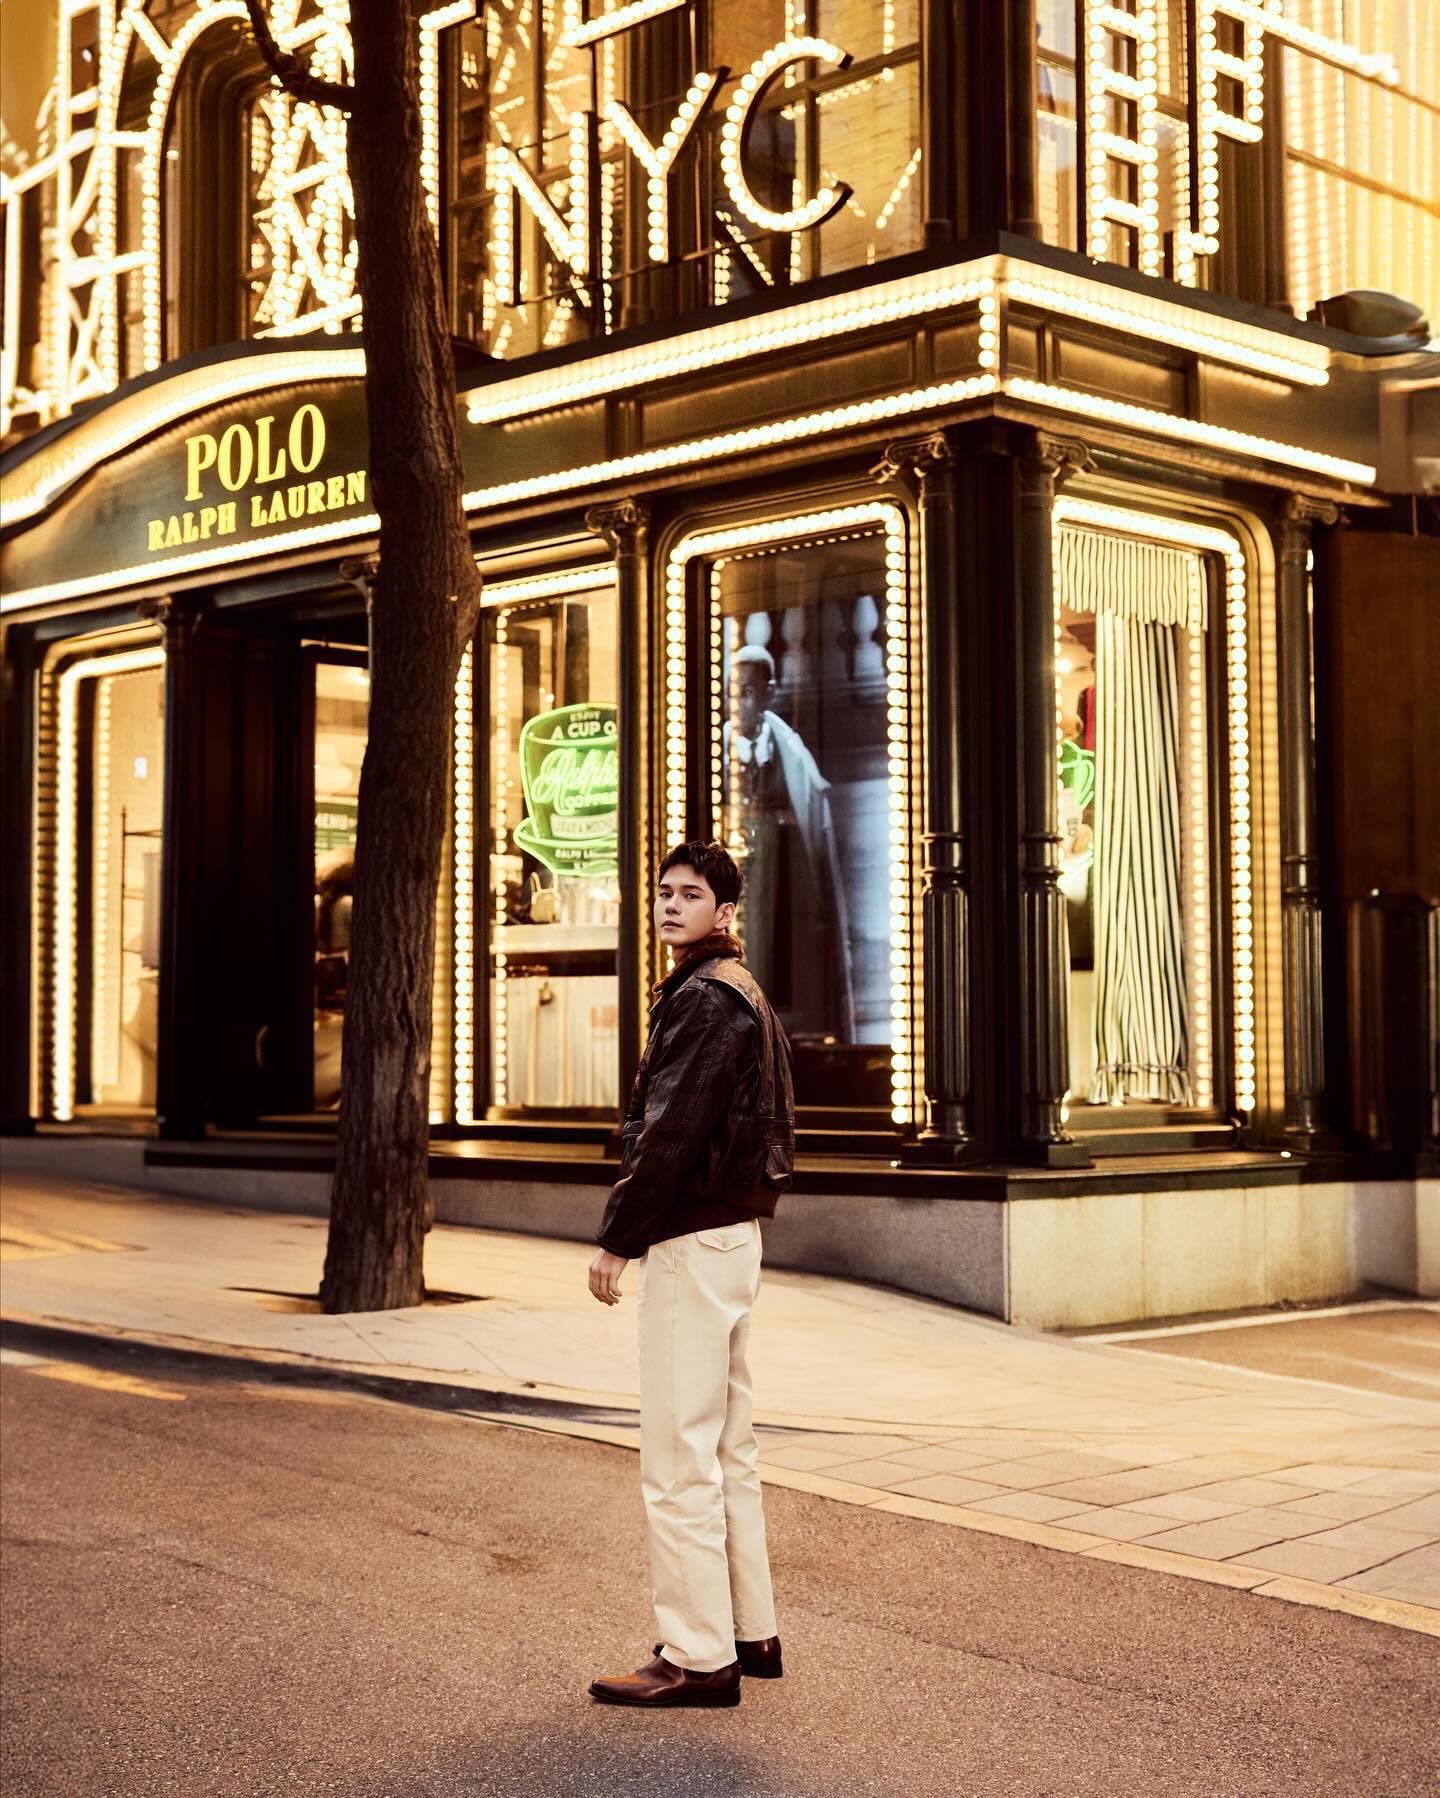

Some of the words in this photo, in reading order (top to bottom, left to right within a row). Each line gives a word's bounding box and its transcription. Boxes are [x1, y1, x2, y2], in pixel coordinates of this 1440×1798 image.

[493, 36, 854, 307] NYC
[184, 403, 326, 501] POLO
[147, 501, 237, 552] RALPH
[250, 470, 367, 528] LAUREN
[551, 725, 564, 740] A
[567, 720, 601, 738] CUP
[603, 720, 617, 736] O
